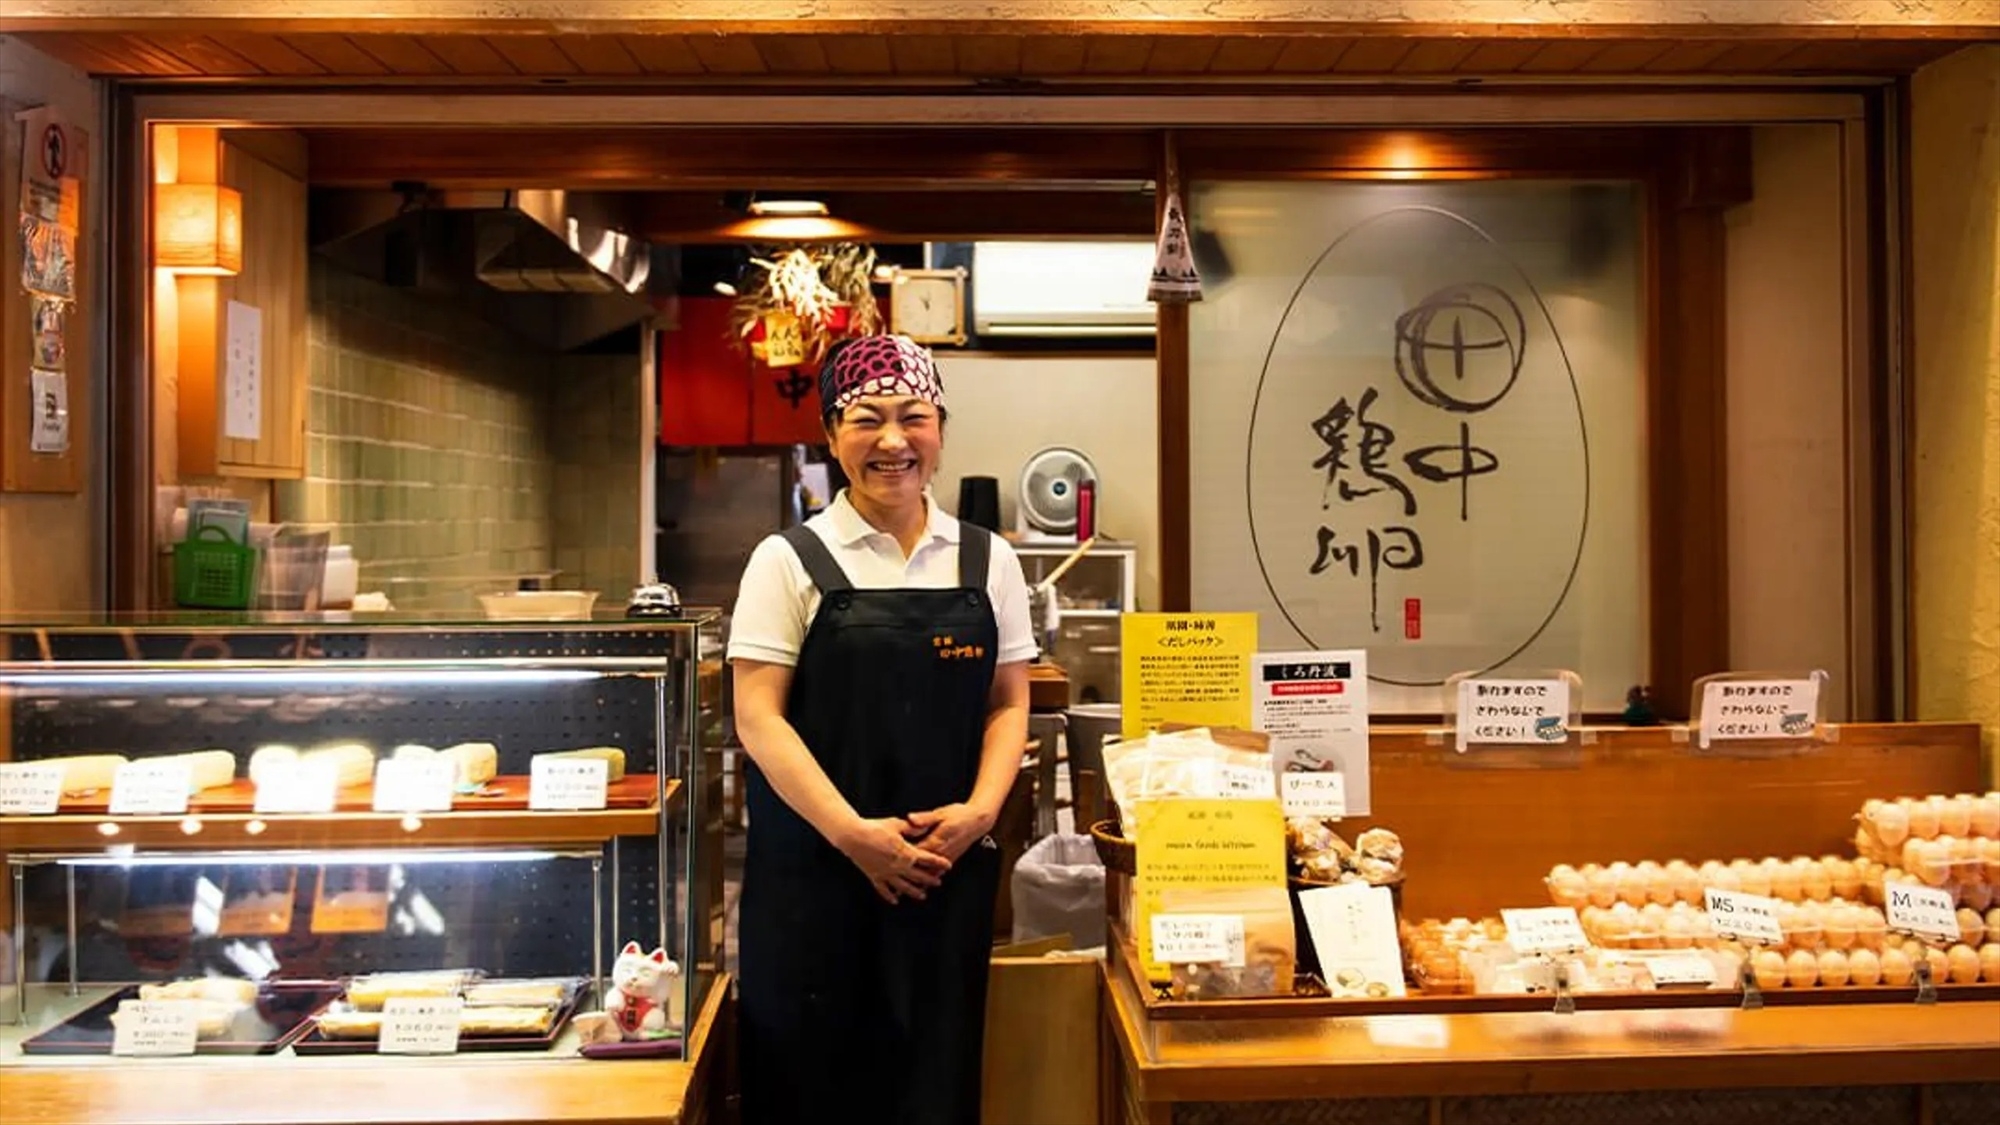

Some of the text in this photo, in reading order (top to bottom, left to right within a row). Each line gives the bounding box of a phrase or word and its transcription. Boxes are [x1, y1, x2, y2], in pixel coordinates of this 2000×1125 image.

[1476, 684, 1548, 697] 割れますので
[1722, 685, 1793, 697] 割れますので
[1475, 705, 1545, 716] さわらないで
[1721, 704, 1789, 715] さわらないで
[1711, 896, 1735, 914] MS
[1892, 890, 1912, 909] M
